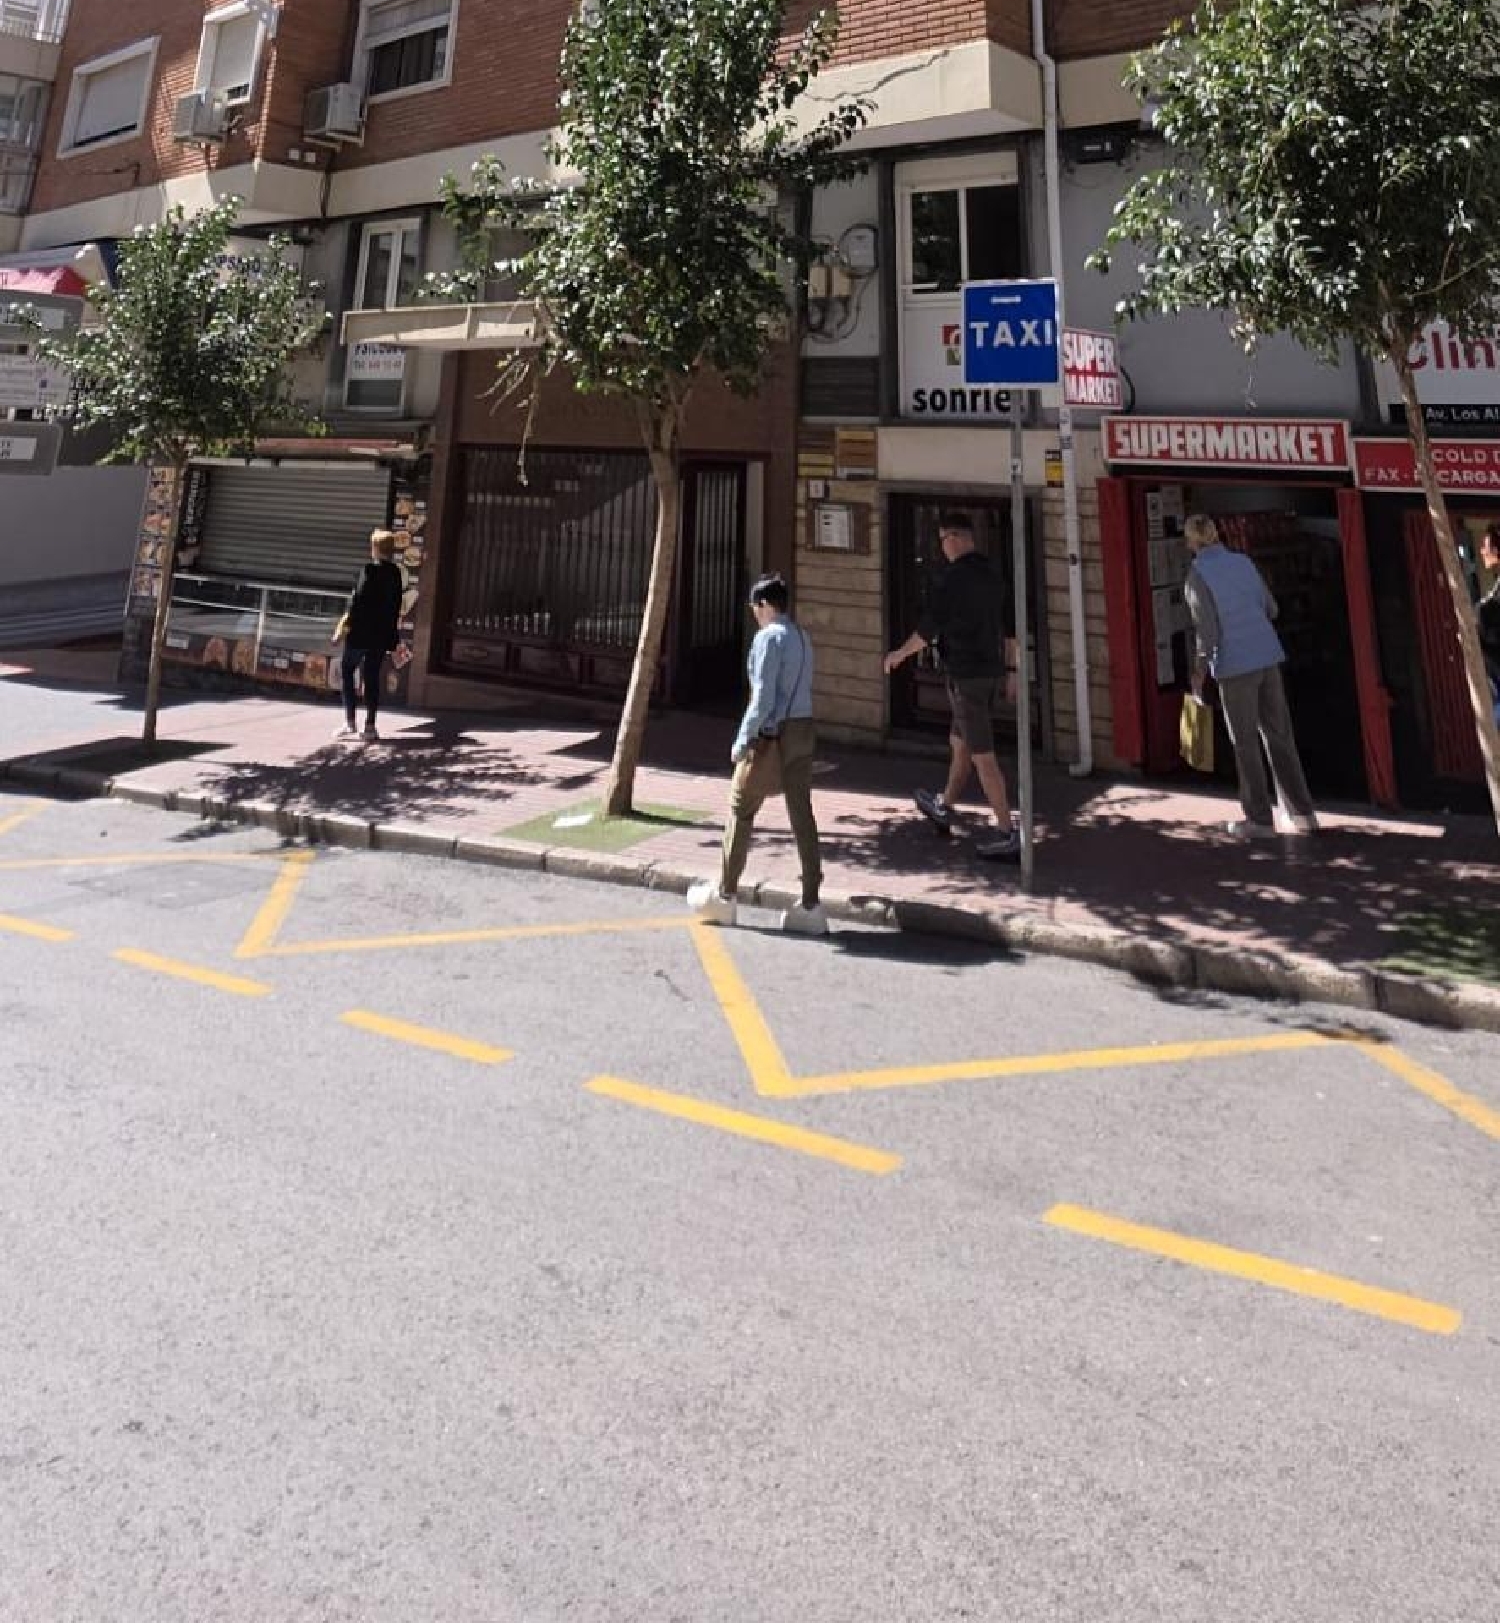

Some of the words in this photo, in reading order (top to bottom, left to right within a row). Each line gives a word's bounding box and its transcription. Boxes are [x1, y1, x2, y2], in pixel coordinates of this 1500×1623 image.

[968, 320, 1053, 348] TAXI
[1063, 332, 1116, 373] SUPER
[1064, 374, 1120, 404] MARKET
[1451, 406, 1479, 420] Los
[1115, 422, 1335, 463] SUPERMARKET
[1431, 448, 1487, 464] COLD
[1365, 467, 1400, 482] FAX
